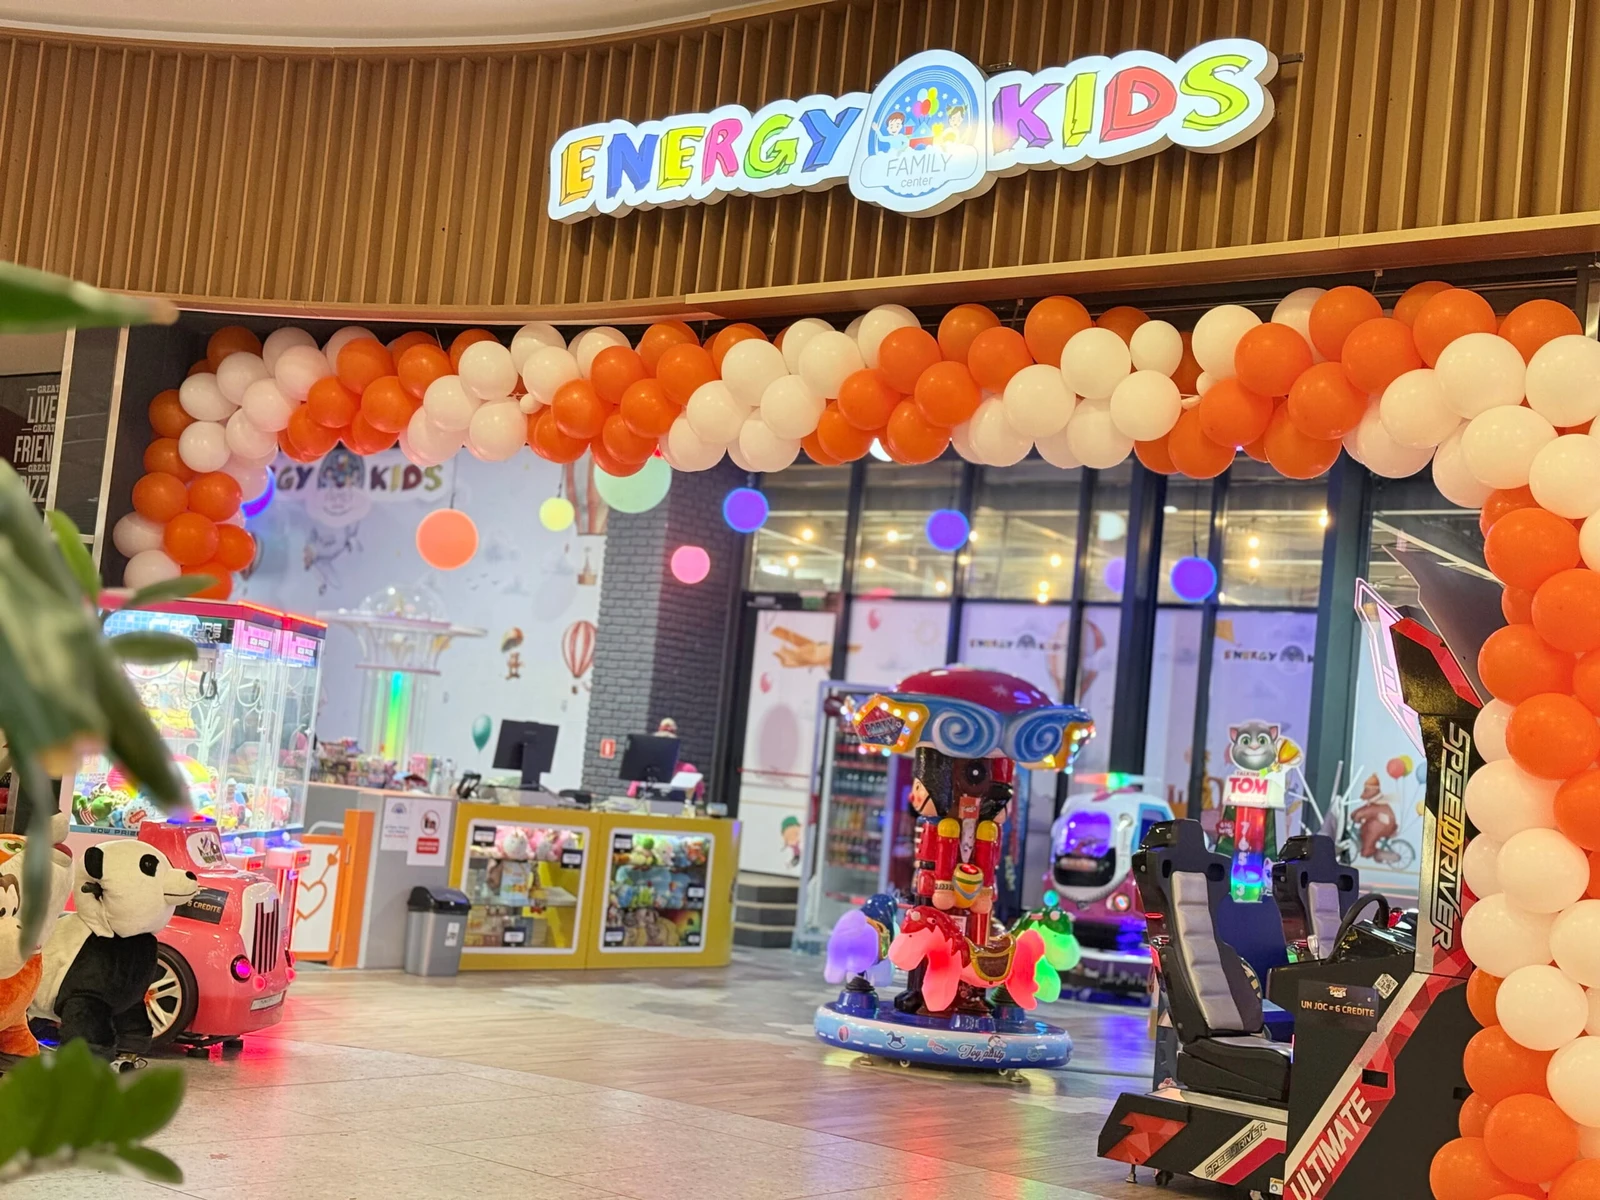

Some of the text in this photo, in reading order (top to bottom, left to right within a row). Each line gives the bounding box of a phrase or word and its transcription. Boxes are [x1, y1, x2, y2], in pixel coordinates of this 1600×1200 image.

[558, 54, 1252, 206] ENERGY KIDS
[886, 153, 953, 177] FAMILY
[900, 176, 934, 188] center
[27, 395, 58, 424] LIVE
[13, 434, 54, 463] FRIEN
[370, 464, 443, 492] KIDS
[1224, 649, 1277, 661] ENERGY
[1229, 777, 1268, 795] TOM
[90, 827, 111, 835] WOW
[193, 901, 222, 914] CREDITE
[1301, 1000, 1313, 1010] UN
[1313, 1002, 1328, 1011] JOC
[1335, 1005, 1341, 1013] 6
[1342, 1005, 1375, 1018] CREDITE
[1289, 1087, 1373, 1200] ULTIMATE
